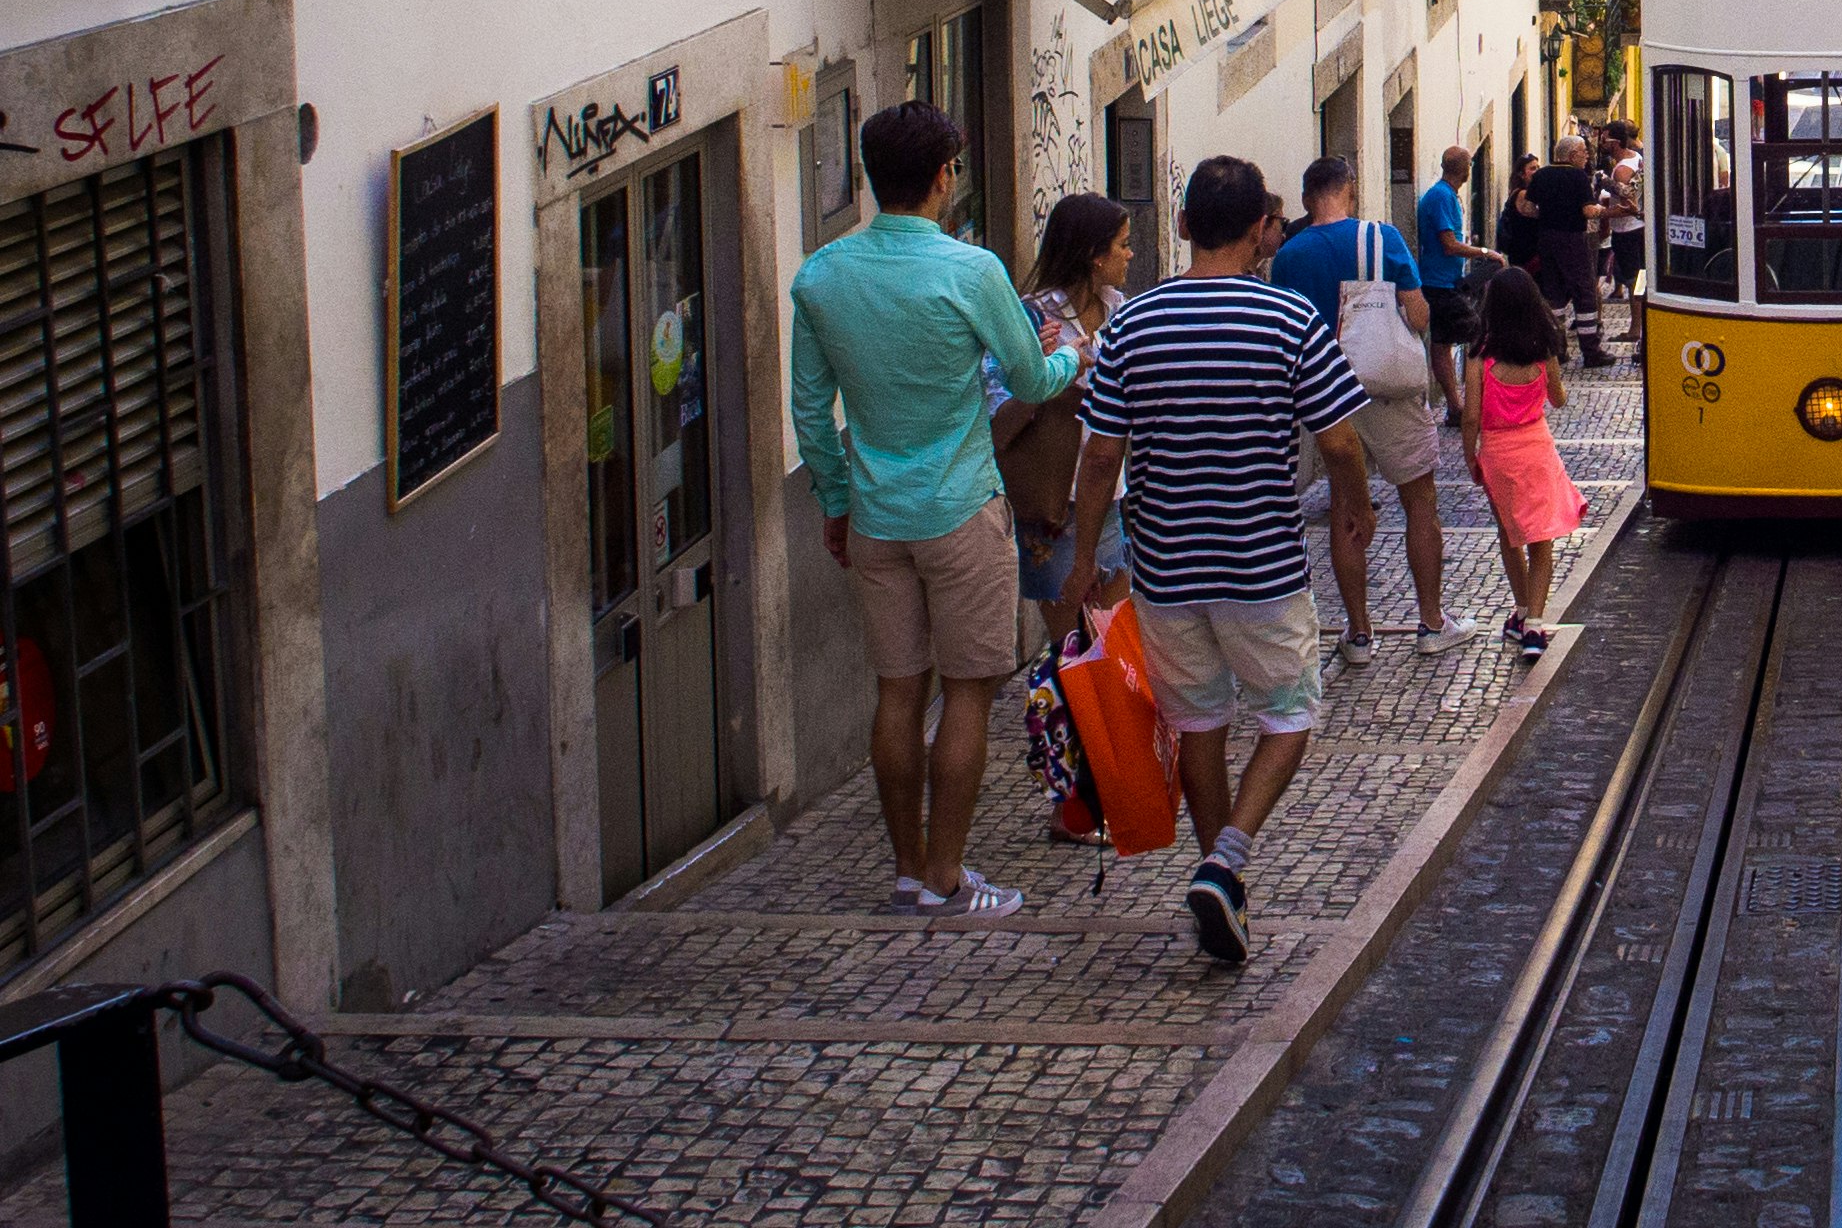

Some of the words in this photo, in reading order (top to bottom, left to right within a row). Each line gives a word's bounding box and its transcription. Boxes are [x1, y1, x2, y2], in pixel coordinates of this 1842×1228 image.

[1138, 19, 1186, 86] CASA
[656, 74, 677, 125] 74
[1669, 229, 1693, 241] 3.70
[1697, 232, 1704, 242] €
